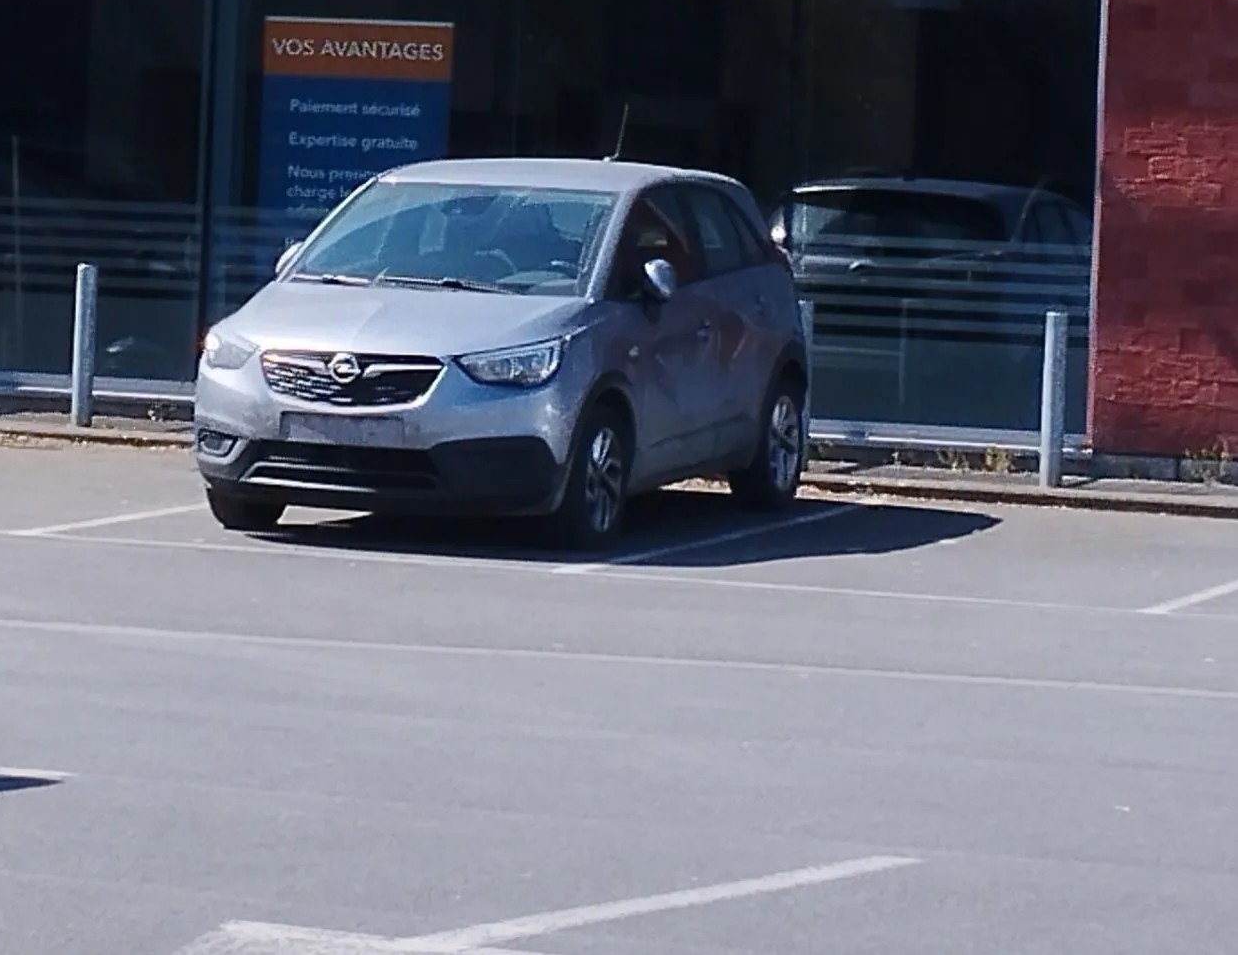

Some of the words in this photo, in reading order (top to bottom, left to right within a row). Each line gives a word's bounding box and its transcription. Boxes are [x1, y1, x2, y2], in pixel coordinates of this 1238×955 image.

[272, 38, 315, 56] VOS
[320, 39, 444, 61] AVANTAGES
[289, 98, 358, 115] Paiement
[288, 131, 358, 149] Expertise
[361, 135, 419, 152] gratuite
[287, 164, 325, 179] Nous
